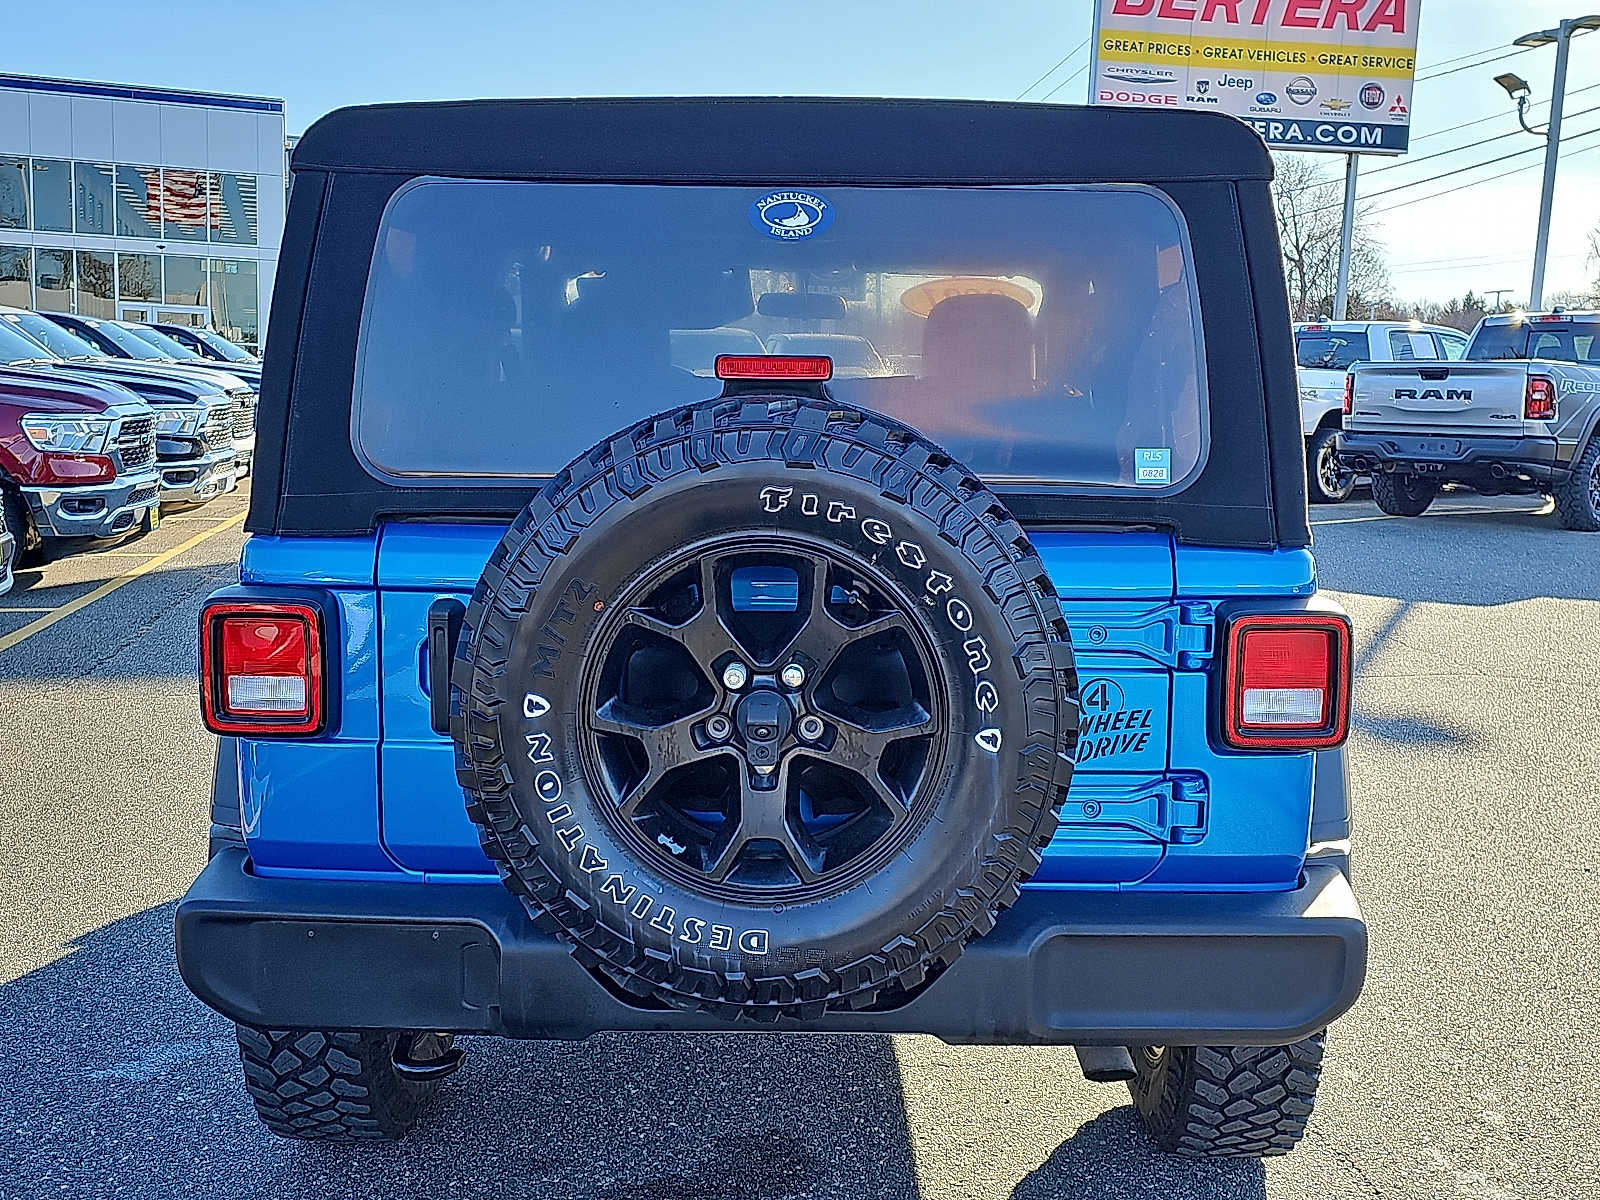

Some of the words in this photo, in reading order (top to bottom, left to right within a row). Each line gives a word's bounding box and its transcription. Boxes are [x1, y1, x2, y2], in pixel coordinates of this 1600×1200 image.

[1103, 39, 1144, 53] GREAT
[1147, 42, 1191, 57] PRICES
[1202, 46, 1244, 60] GREAT
[1247, 49, 1306, 64] VEHICLES
[1318, 53, 1359, 67] GREAT
[1361, 55, 1414, 70] SERVICE
[1107, 67, 1174, 77] CHRYSLER
[1217, 74, 1254, 91] Jeep
[1099, 91, 1178, 105] DODGE
[1185, 95, 1219, 104] RAM
[756, 192, 828, 210] NANTUCKET
[770, 227, 813, 237] ISLAND
[1393, 388, 1474, 402] RAM
[1143, 451, 1163, 461] RLS
[760, 485, 1000, 714] Firestone
[1085, 683, 1110, 712] 4
[1079, 709, 1153, 737] WHEEL
[1076, 732, 1152, 765] DRIVE
[526, 732, 770, 955] DESTINATION
